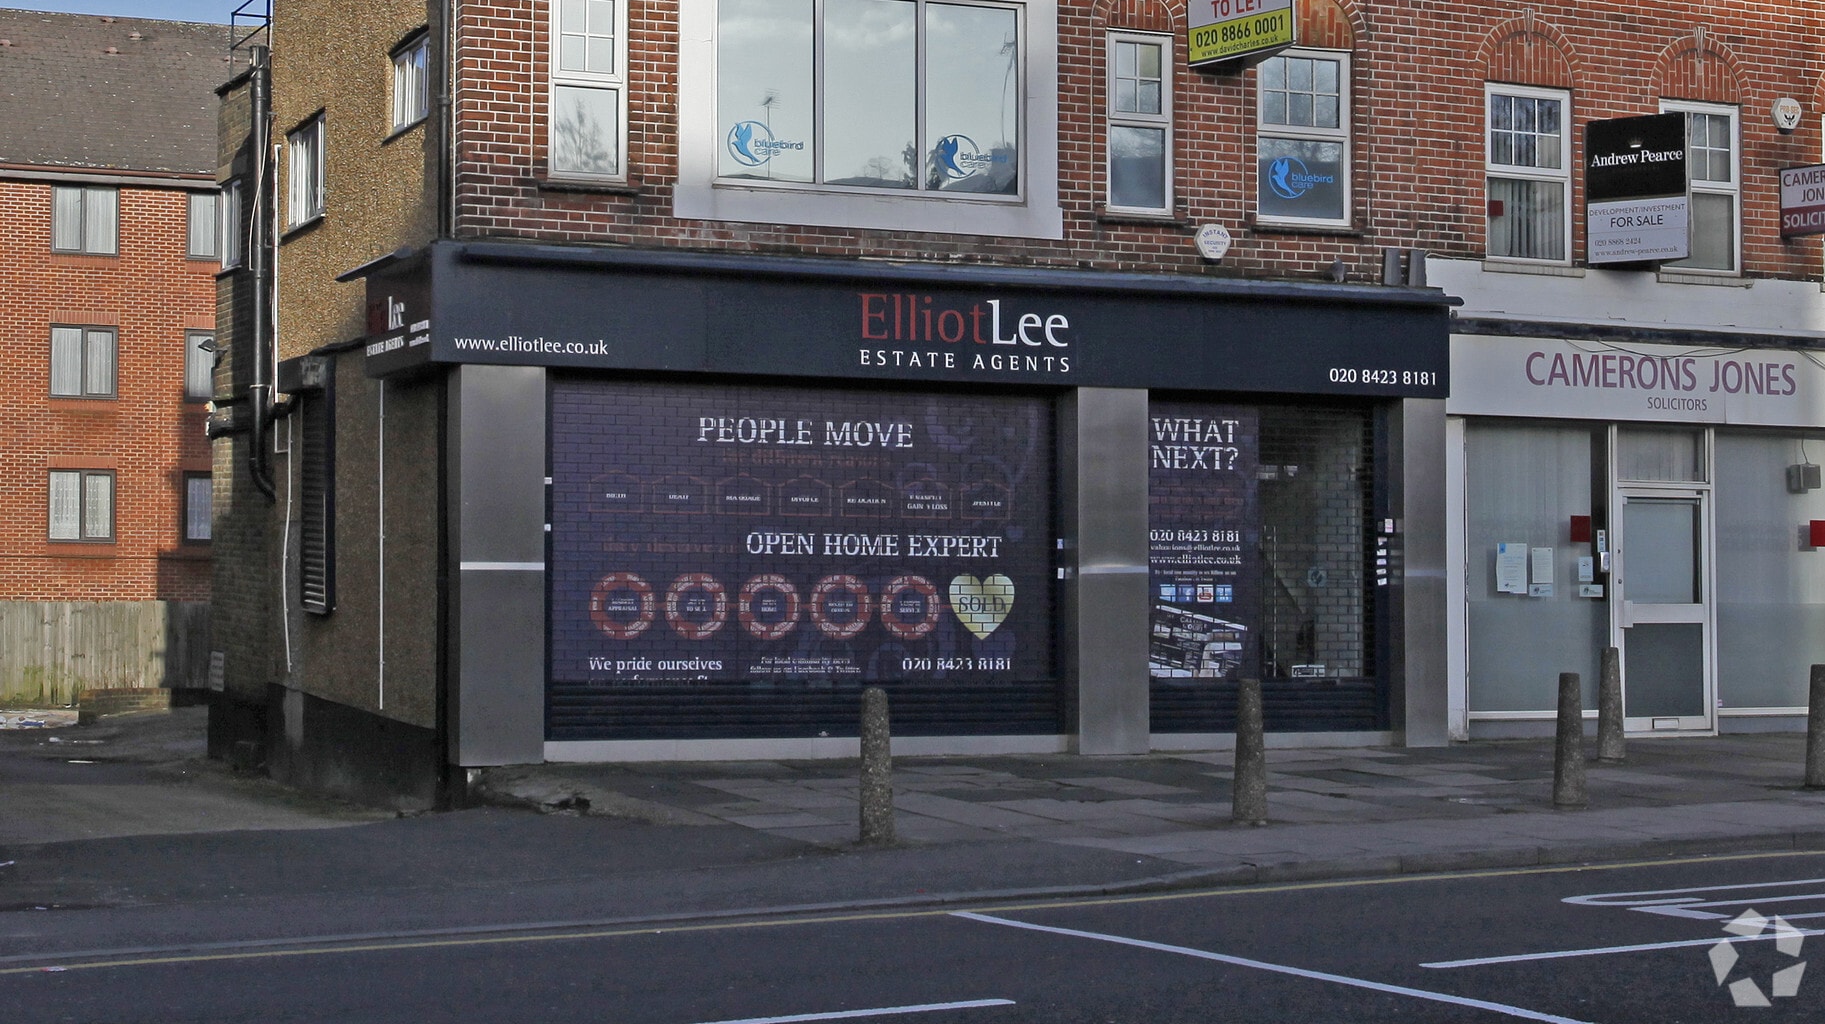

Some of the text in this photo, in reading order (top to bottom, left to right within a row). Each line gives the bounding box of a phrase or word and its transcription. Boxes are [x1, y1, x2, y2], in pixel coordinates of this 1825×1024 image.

[1211, 0, 1230, 18] TO
[1196, 14, 1284, 48] 020 8866 0001
[1201, 34, 1279, 57] www.davidcharles.co.uk
[754, 138, 804, 150] bluebird
[754, 148, 781, 156] care
[1590, 149, 1683, 167] Andrew Pearce
[1291, 172, 1334, 184] bluebird
[1291, 181, 1314, 189] care
[1589, 203, 1685, 216] DEVELOPMENT/INVESTMENT
[1610, 214, 1664, 228] FOR SALE
[1202, 229, 1229, 239] INSTANT
[1594, 245, 1679, 257] www.andrew-pearce.co.uk
[454, 336, 608, 355] www.elliotlee.co.uk
[859, 349, 1070, 373] ESTATE AGENTS
[1329, 368, 1437, 386] 020 8423 8181
[1525, 351, 1798, 396] CAMERONS JONES
[1647, 396, 1708, 411] SOLICITORS
[697, 416, 914, 449] PEOPLE MOVE
[1152, 418, 1239, 443] WHAT
[1152, 447, 1239, 470] NEXT?
[746, 531, 1003, 558] OPEN HOME EXPERT
[1150, 529, 1174, 542] 020
[958, 596, 1006, 614] SOLD
[588, 656, 723, 674] We pride ourselves
[902, 657, 1011, 670] 020 8423 8181
